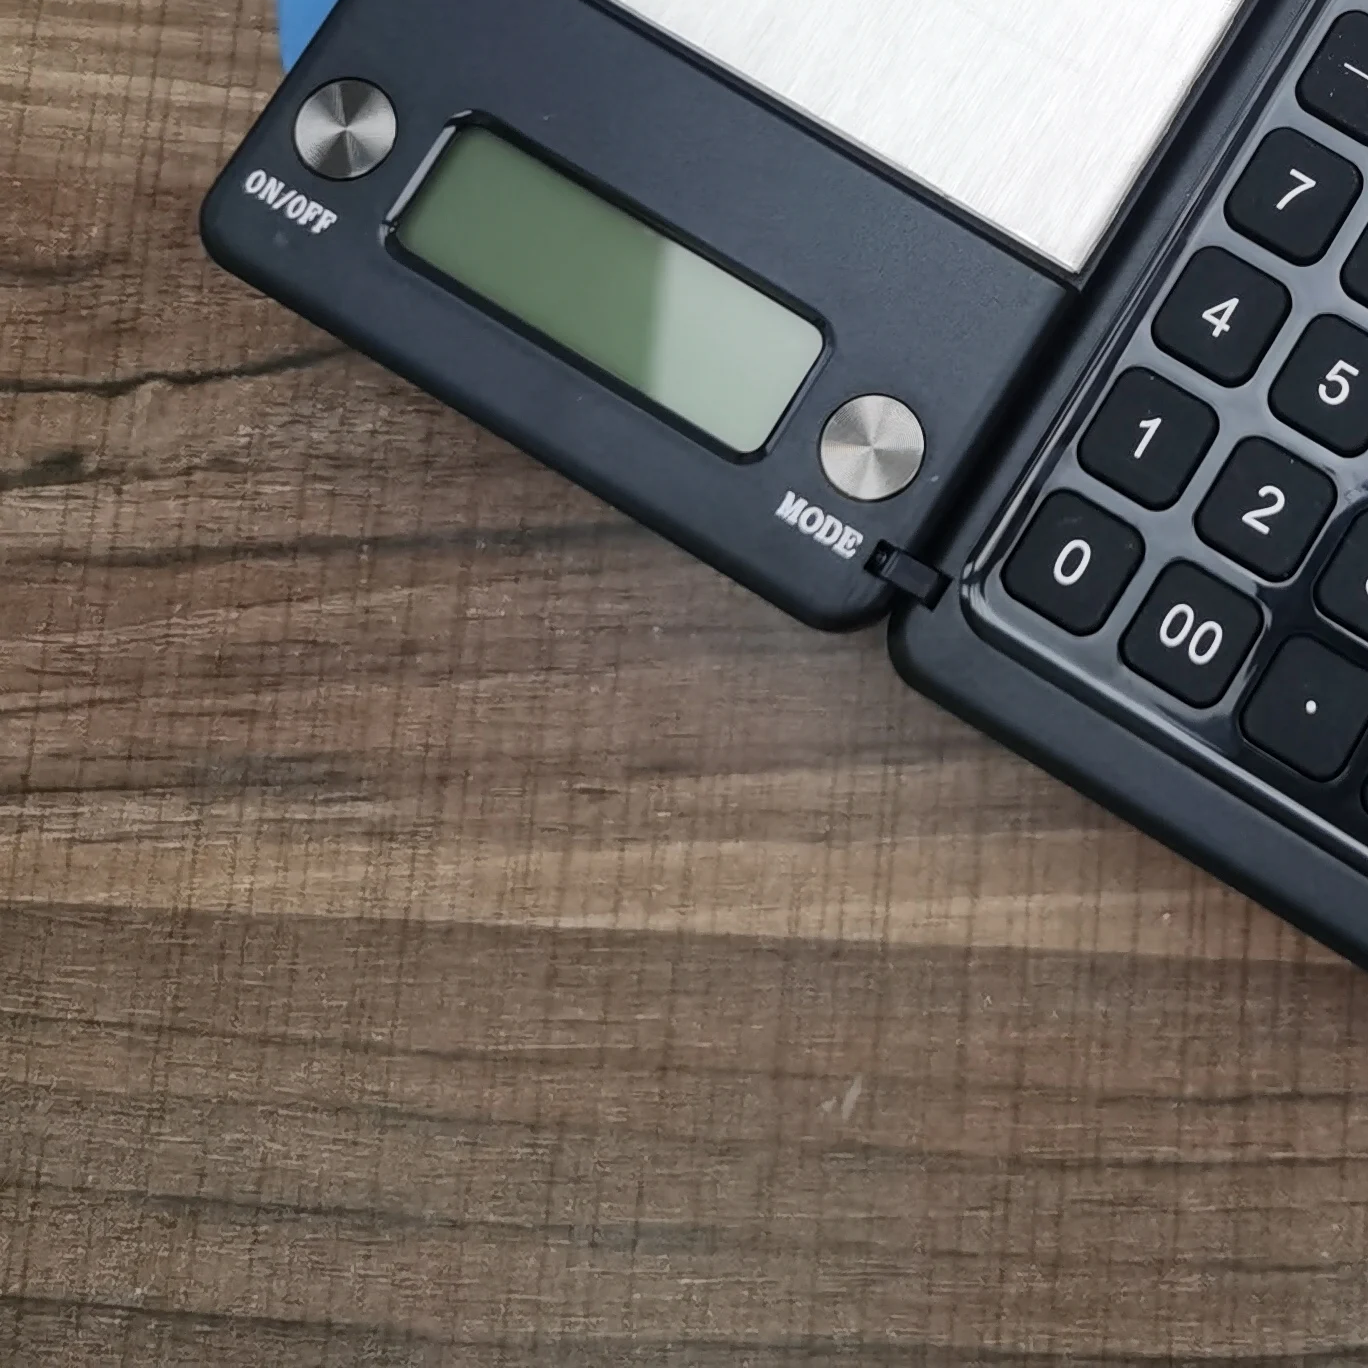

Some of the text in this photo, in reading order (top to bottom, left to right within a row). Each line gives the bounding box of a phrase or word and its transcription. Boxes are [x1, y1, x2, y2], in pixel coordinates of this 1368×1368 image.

[245, 170, 337, 233] ON/OFF
[1276, 169, 1316, 210] 7
[1202, 298, 1239, 337] 4
[1319, 360, 1359, 405] 5
[1134, 418, 1161, 458] 1
[775, 491, 863, 559] MODE
[1242, 486, 1285, 534] 2
[1054, 540, 1091, 585] 0
[1160, 604, 1222, 664] 00
